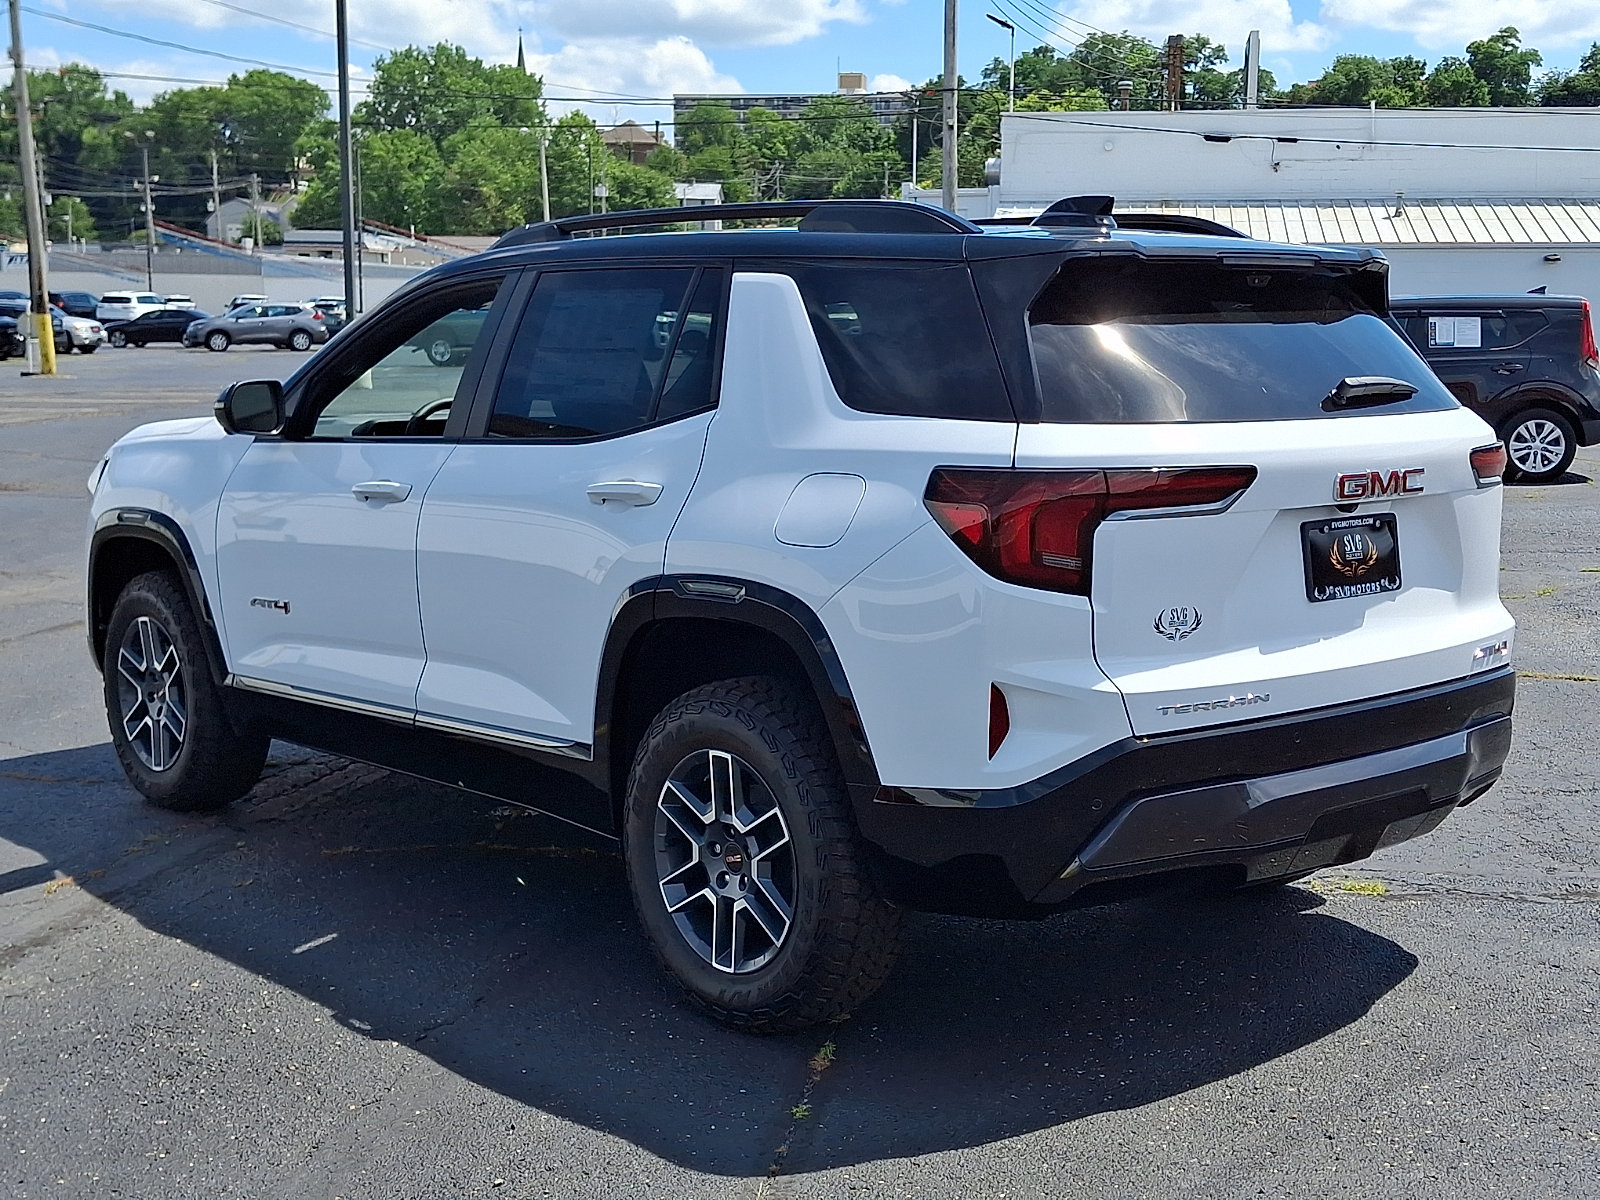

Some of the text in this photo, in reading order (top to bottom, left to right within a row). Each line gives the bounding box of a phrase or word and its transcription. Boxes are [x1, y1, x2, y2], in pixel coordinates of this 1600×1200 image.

[1334, 468, 1425, 501] GMC
[1331, 518, 1374, 529] SVGMOTORS.COM
[1343, 533, 1363, 553] SVG
[250, 598, 291, 615] AT4
[1170, 607, 1188, 621] SVG
[1156, 693, 1270, 715] TERRAIN
